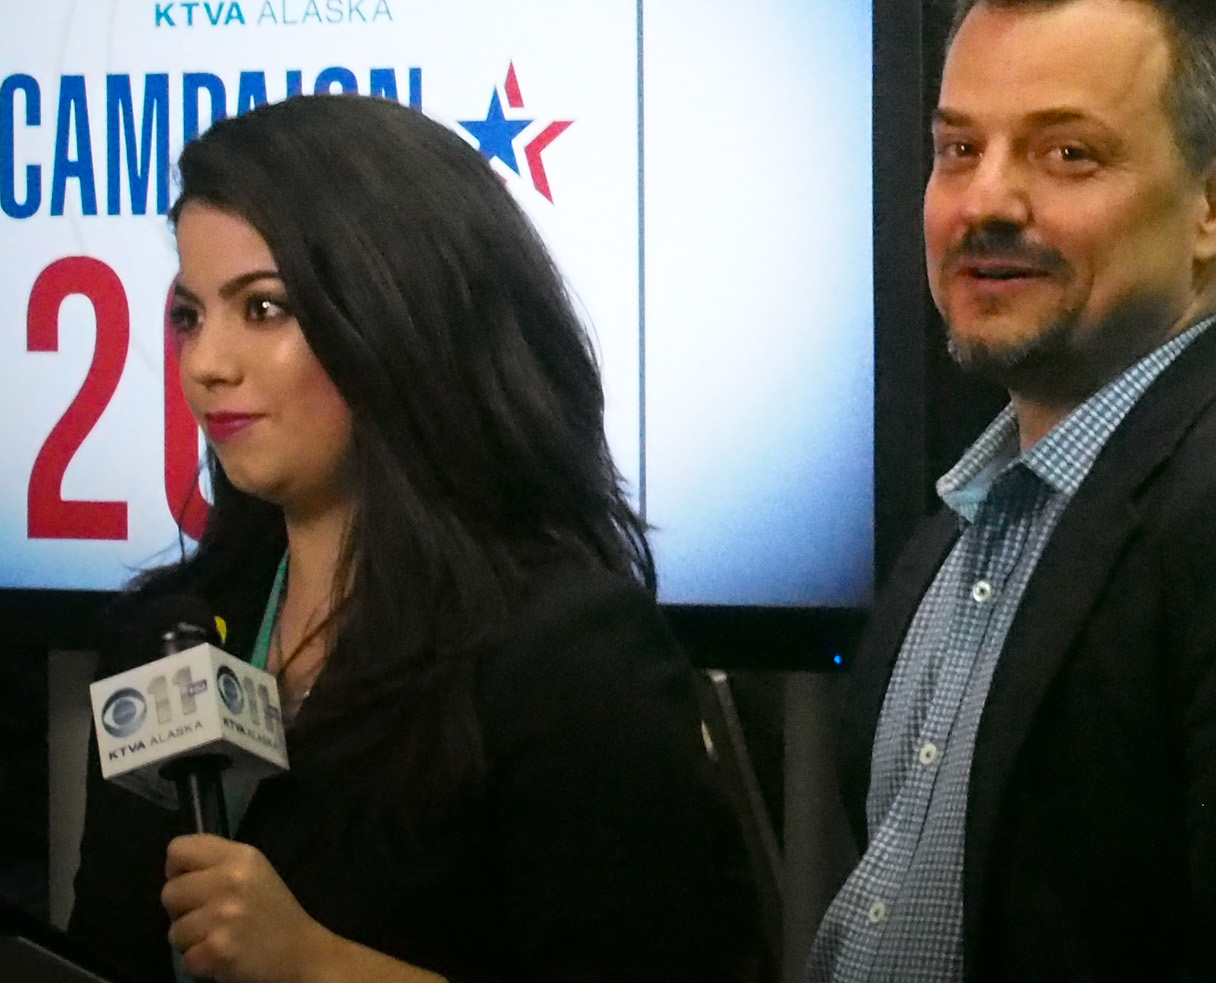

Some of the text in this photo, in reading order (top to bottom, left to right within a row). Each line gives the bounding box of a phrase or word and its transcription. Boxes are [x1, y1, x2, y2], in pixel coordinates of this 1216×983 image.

[154, 0, 246, 28] KTVA
[108, 720, 203, 761] KTVA ALASKA
